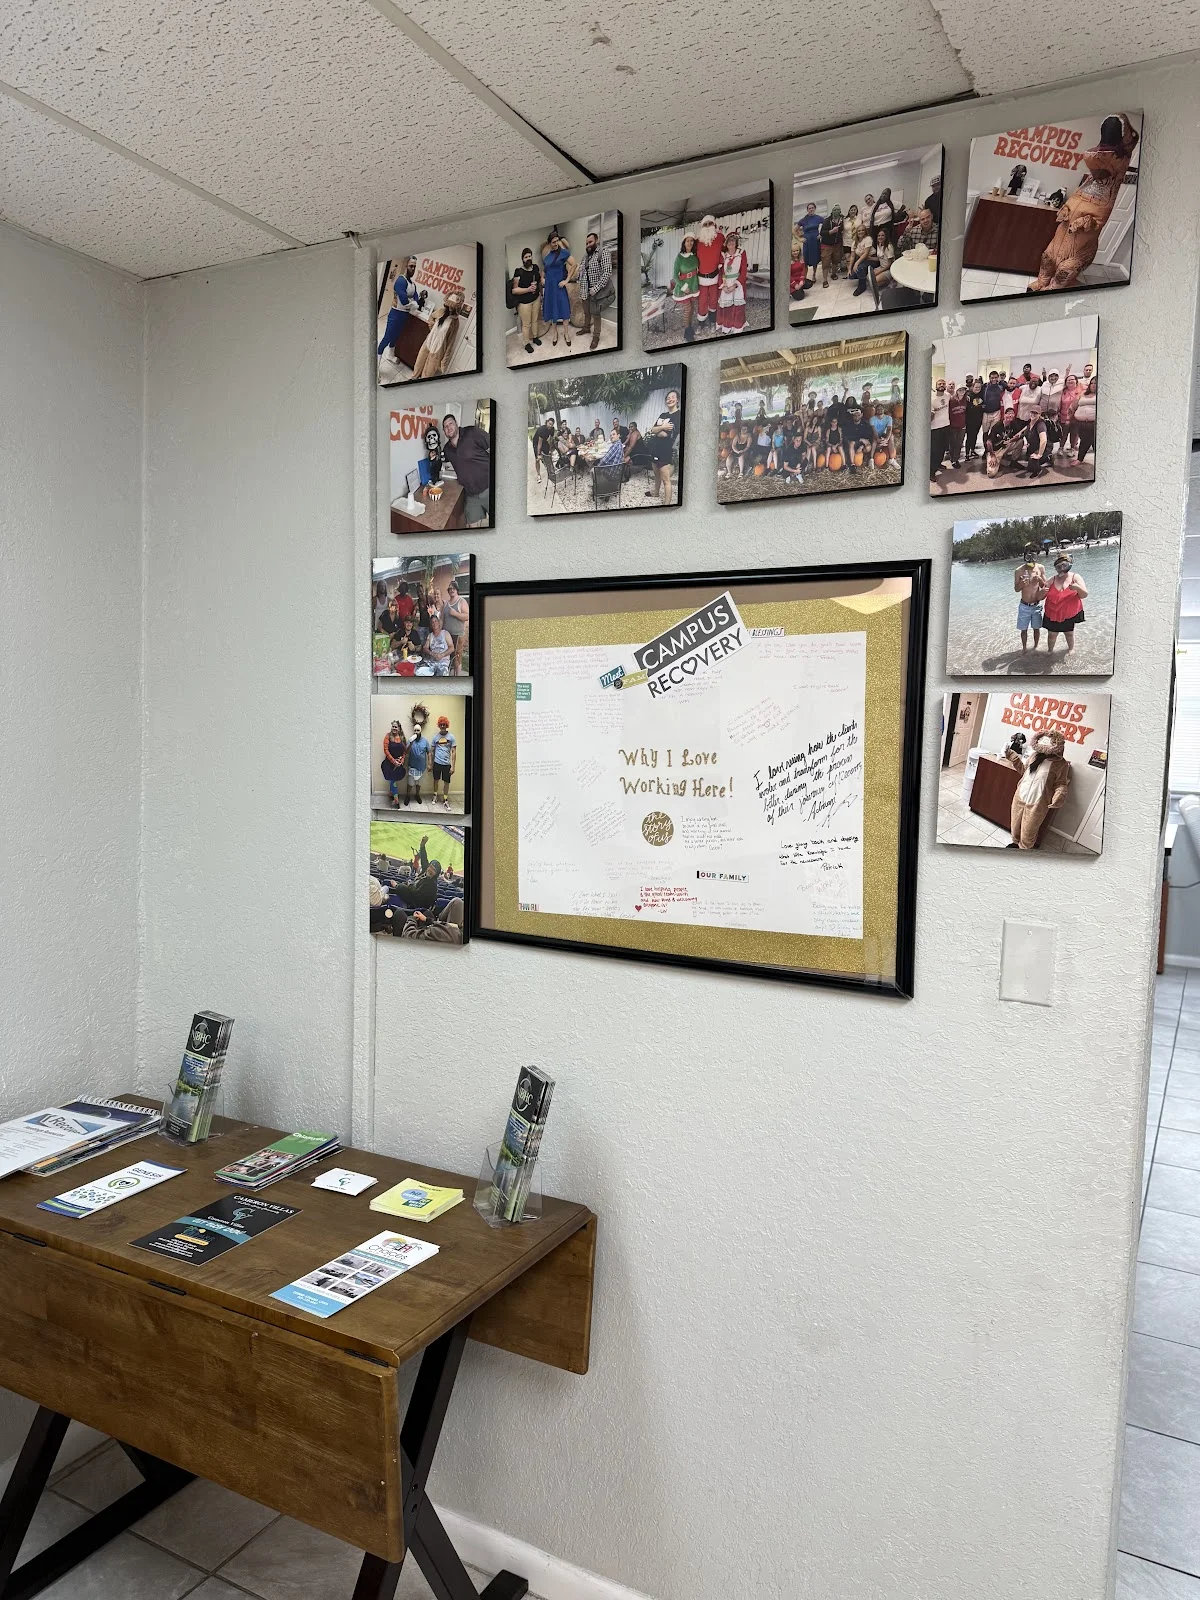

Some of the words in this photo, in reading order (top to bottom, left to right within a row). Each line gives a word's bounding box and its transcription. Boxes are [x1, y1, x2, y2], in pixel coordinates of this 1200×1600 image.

[994, 137, 1084, 171] RECOVERY
[421, 258, 464, 283] CAMPUS
[642, 604, 730, 670] CAMPUS
[601, 667, 624, 686] Meet
[1009, 692, 1087, 722] CAMPUS
[1001, 708, 1095, 745] RECOVERY
[808, 741, 823, 755] how
[618, 748, 658, 768] Why
[667, 749, 672, 767] I
[682, 749, 717, 767] Love
[619, 776, 687, 797] Working
[692, 776, 733, 798] Here!
[779, 772, 791, 787] and
[646, 811, 667, 823] the
[642, 820, 672, 836] story
[648, 832, 659, 845] of
[658, 831, 672, 843] us
[719, 873, 746, 881] FAMILY
[233, 1195, 270, 1208] CAMERON
[269, 1202, 295, 1214] VILLAS
